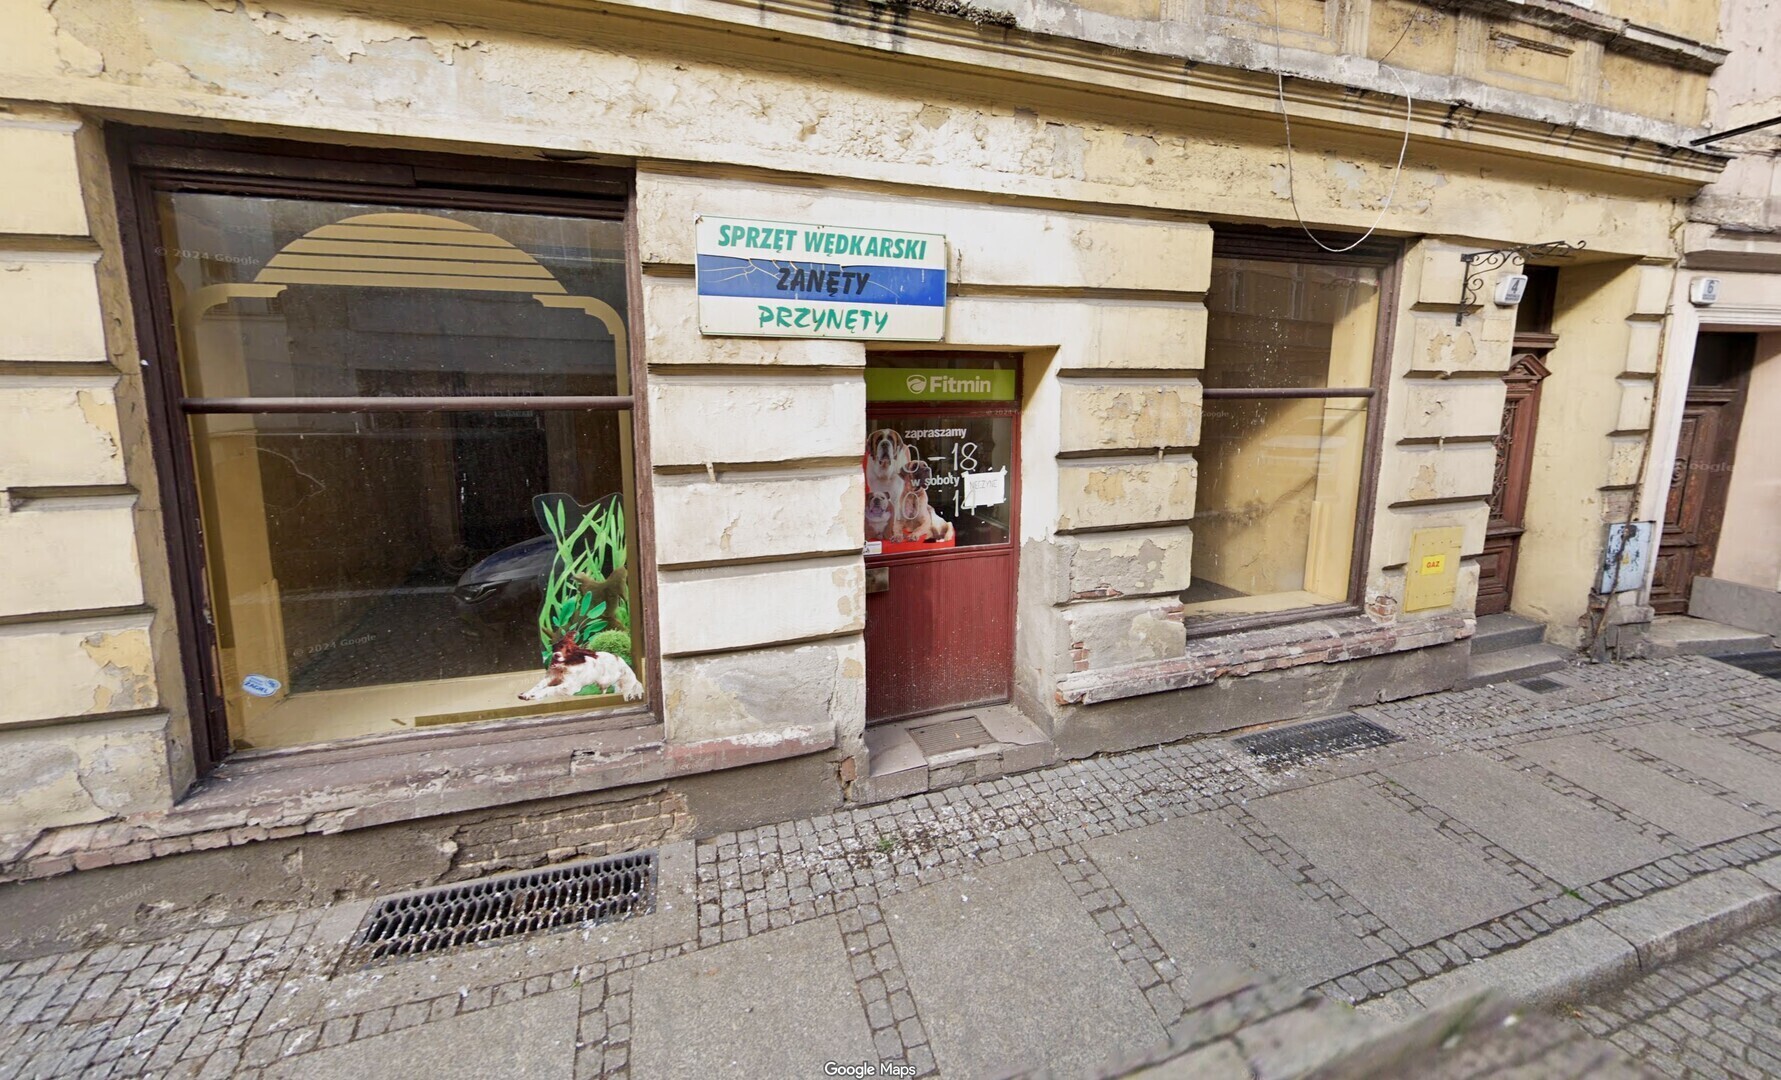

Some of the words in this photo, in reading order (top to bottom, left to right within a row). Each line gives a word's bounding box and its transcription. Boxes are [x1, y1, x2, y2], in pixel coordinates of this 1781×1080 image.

[718, 224, 797, 253] SPRZĘT
[804, 231, 927, 260] WĘDKARSKI
[776, 267, 870, 297] ZANĘTY
[1511, 279, 1521, 294] 4
[1707, 280, 1715, 294] 6
[758, 305, 889, 334] PRZYNĘTY
[929, 375, 992, 393] Fitmin
[905, 427, 967, 440] zapraszamy
[951, 442, 979, 472] 18
[911, 478, 921, 487] w
[924, 472, 960, 487] soboty
[1426, 560, 1440, 568] GAZ
